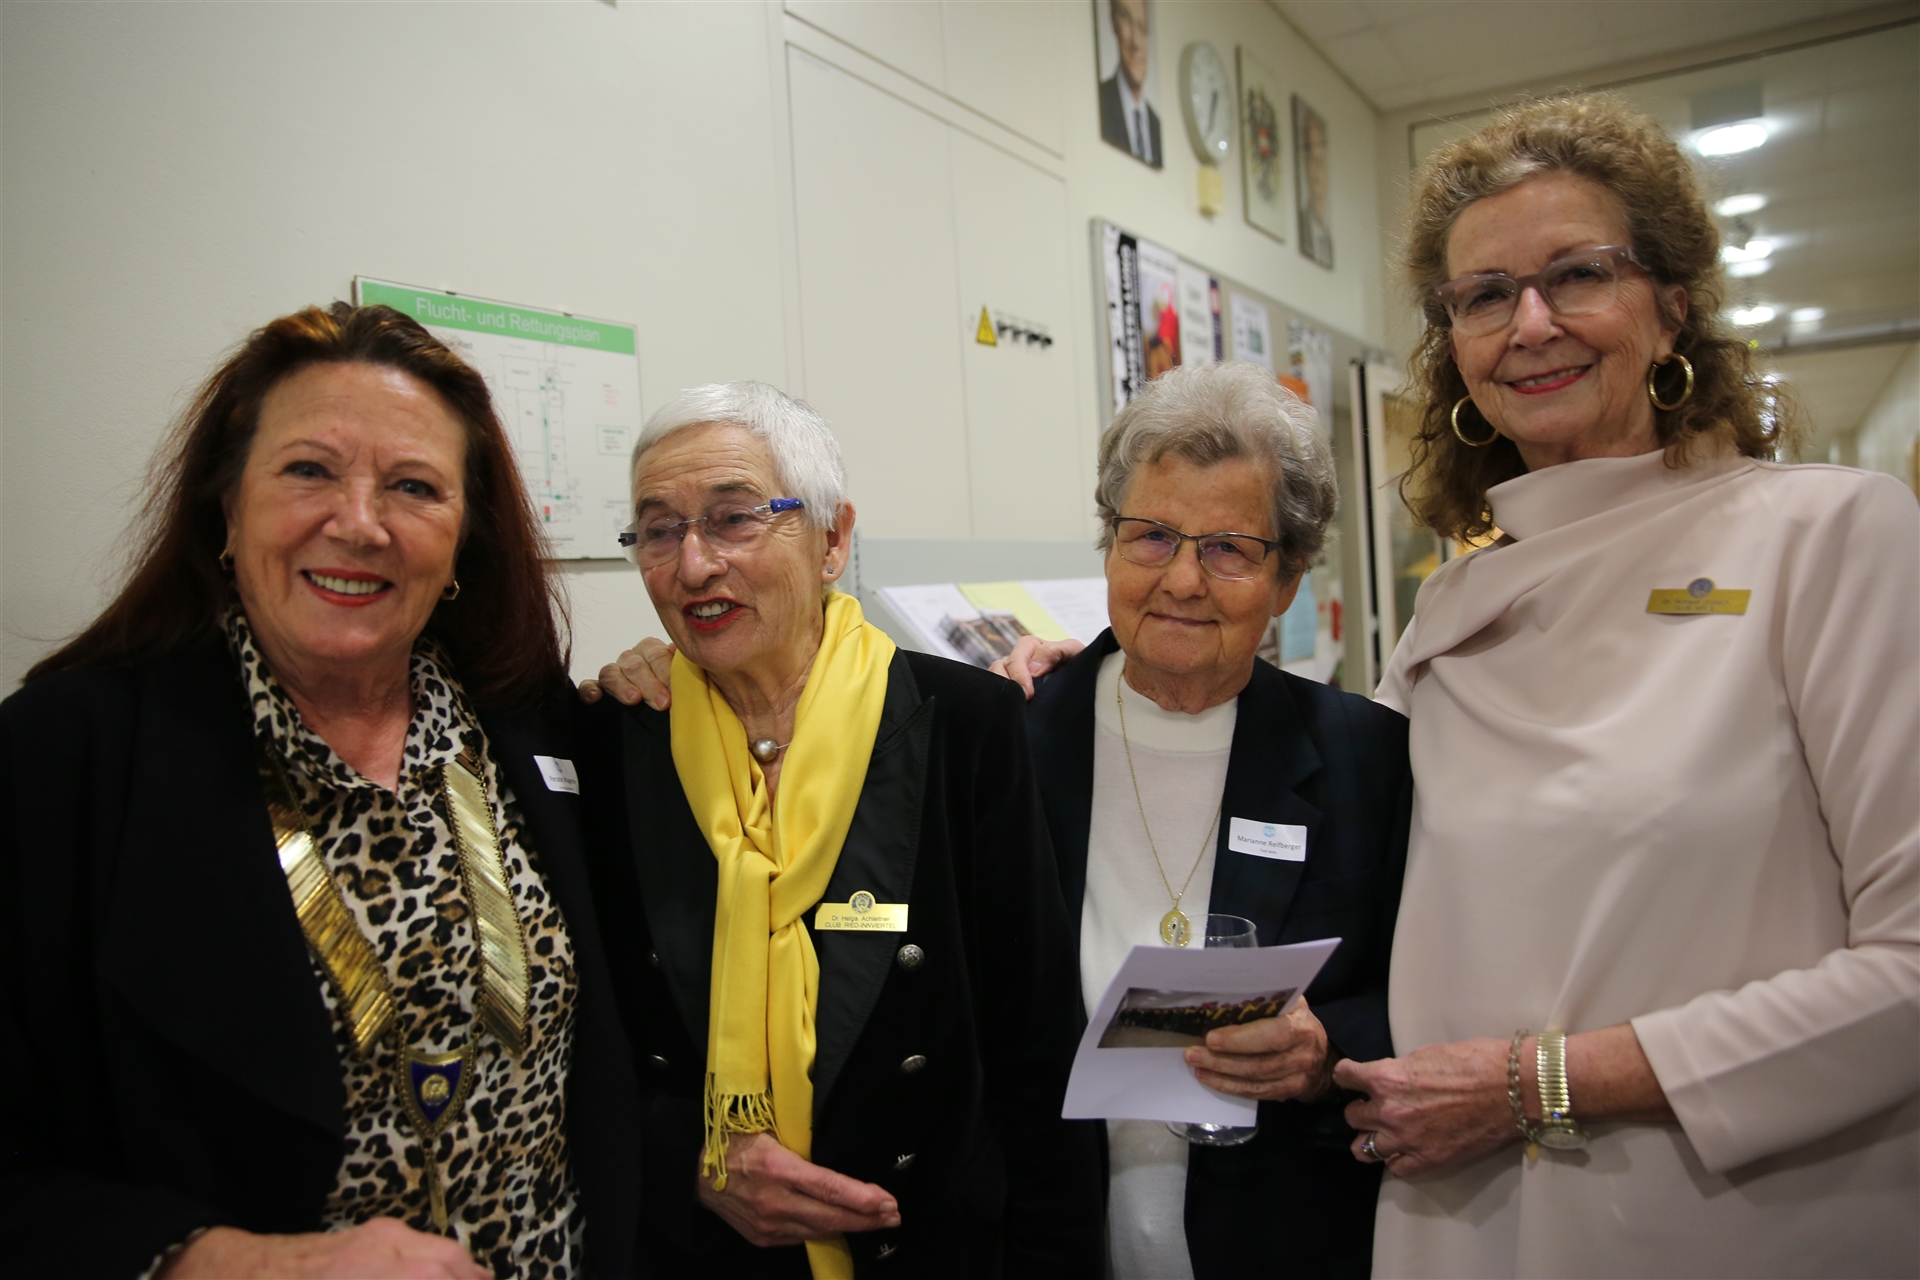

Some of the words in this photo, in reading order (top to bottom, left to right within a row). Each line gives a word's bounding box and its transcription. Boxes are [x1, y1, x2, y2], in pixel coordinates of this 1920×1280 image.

[416, 297, 472, 323] Flucht-
[477, 311, 505, 329] und
[510, 315, 600, 344] Rettungsplan
[1237, 835, 1267, 846] Marianne
[1268, 840, 1302, 851] Reifberger
